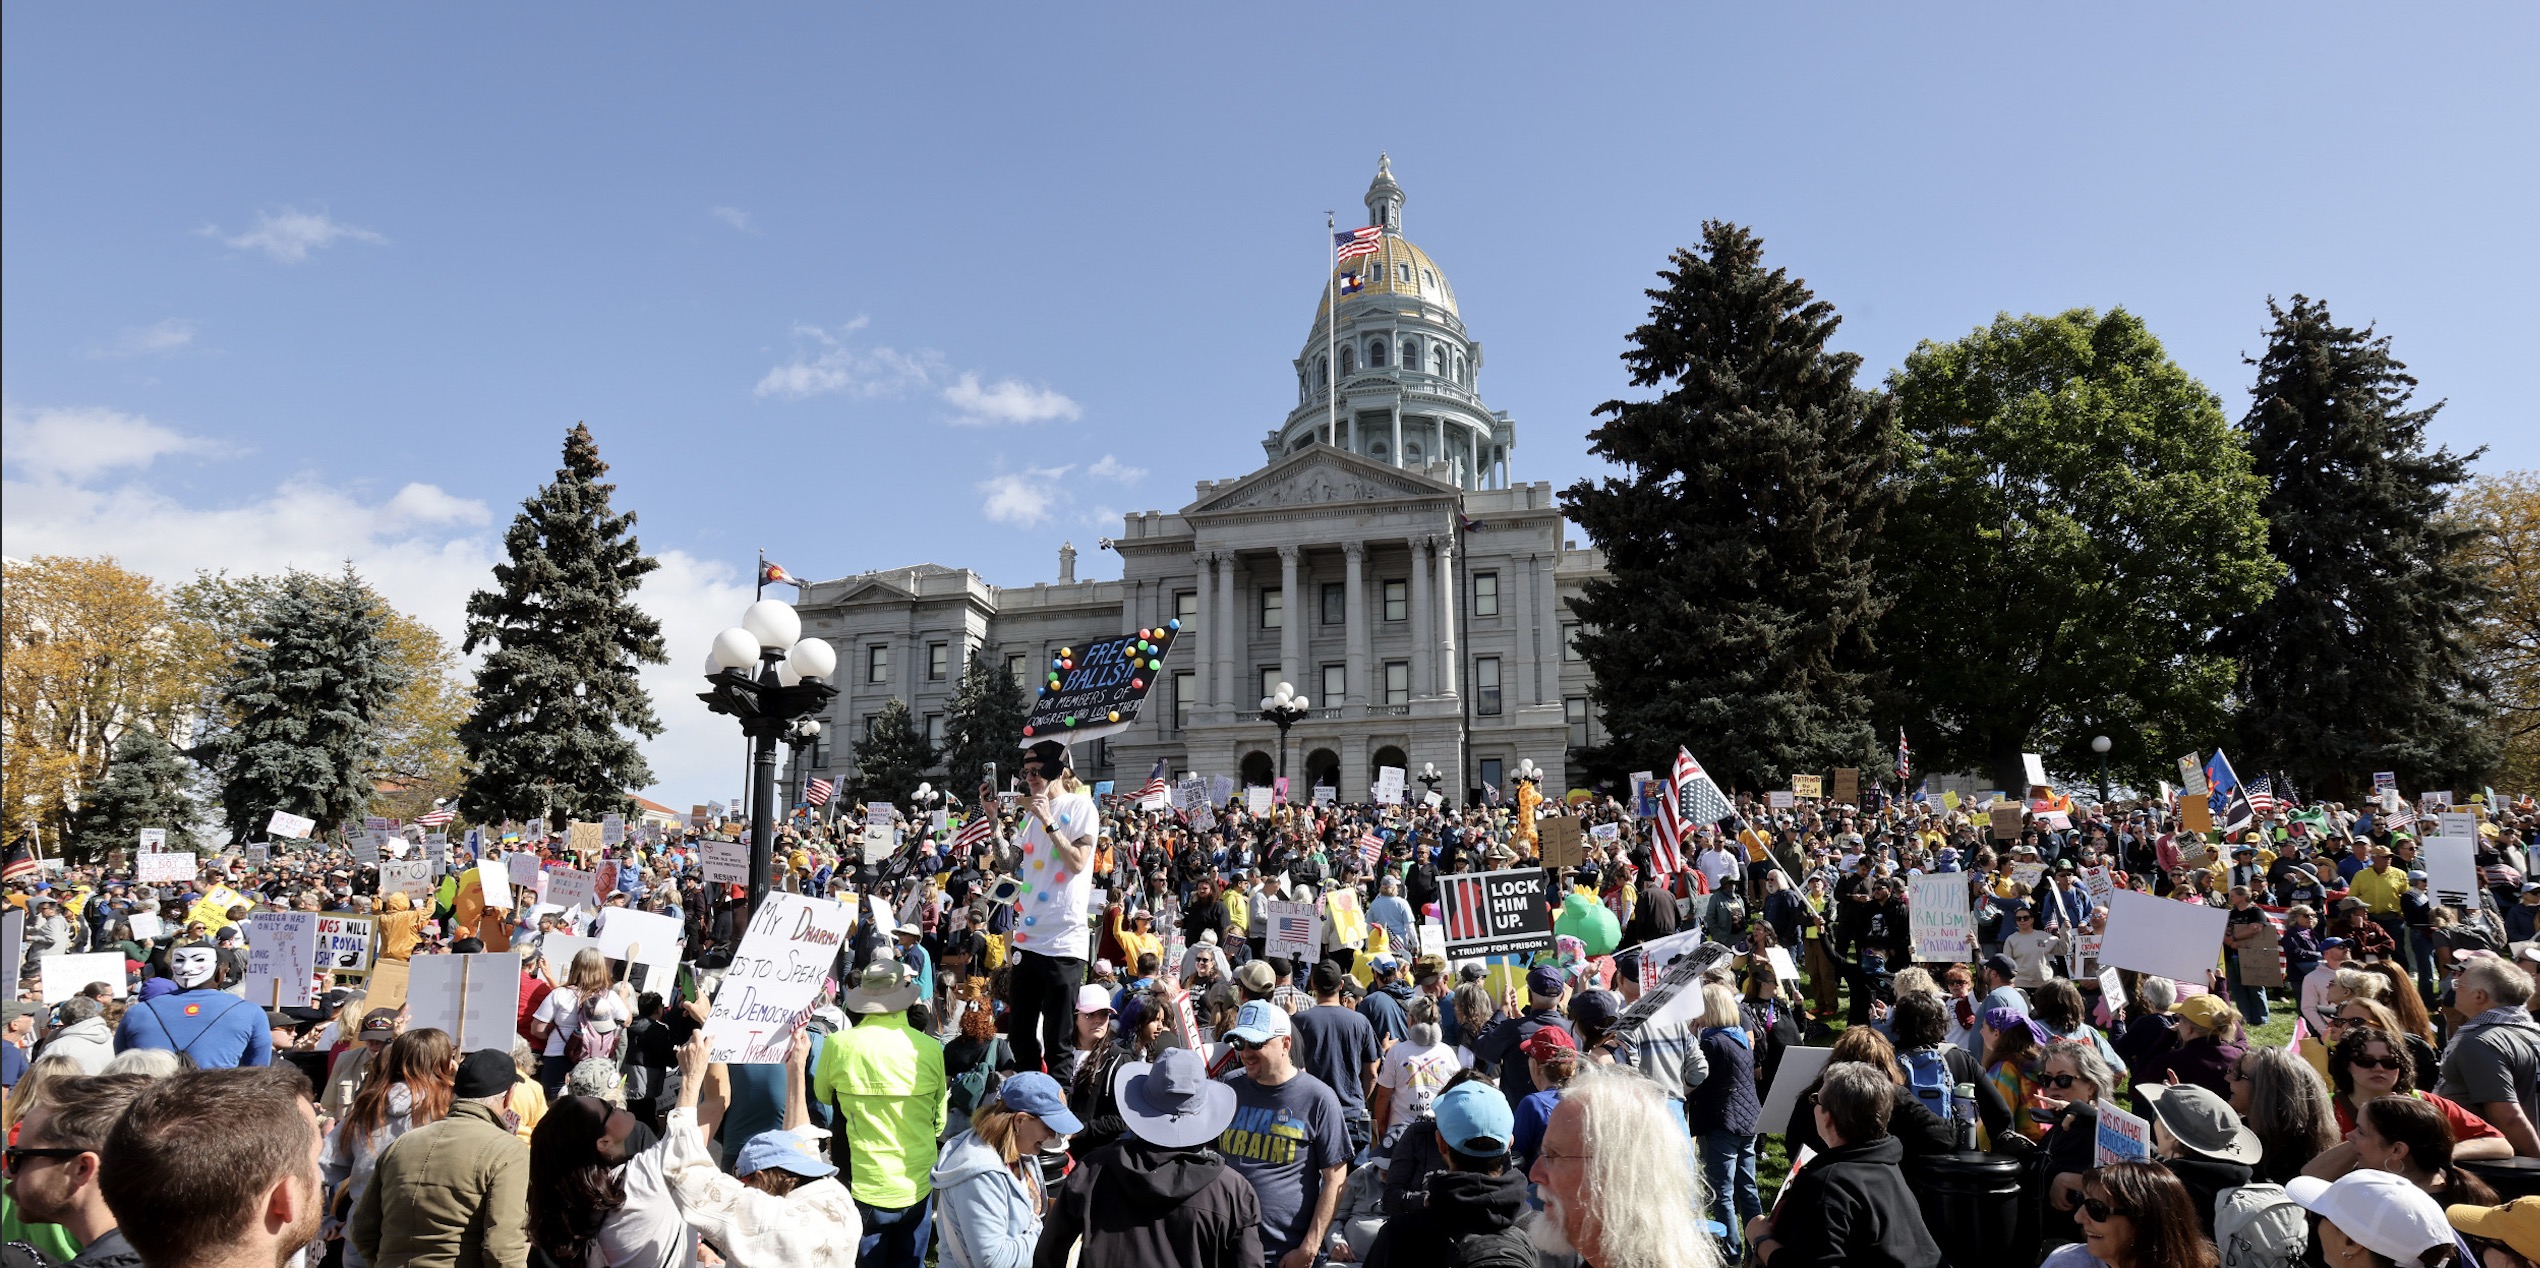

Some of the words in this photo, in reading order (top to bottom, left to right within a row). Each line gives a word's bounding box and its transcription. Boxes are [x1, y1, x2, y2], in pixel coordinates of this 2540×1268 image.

[1082, 637, 1136, 667] FREE
[1062, 660, 1136, 692] BALLS!!
[1036, 699, 1053, 711] FOR
[1056, 689, 1107, 710] MEMBERS
[1114, 686, 1134, 700] OF
[1073, 709, 1087, 720] WHO
[1091, 704, 1115, 719] LOST
[1794, 775, 1820, 783] PATRIOTS
[573, 824, 599, 837] NO
[571, 837, 601, 850] KINGS
[158, 860, 177, 868] NOT
[553, 869, 591, 881] DEMOCRACY
[713, 872, 738, 882] RESIST
[2088, 868, 2100, 877] NO
[968, 878, 984, 887] NO
[1490, 879, 1541, 898] LOCK
[1918, 882, 1962, 909] YOUR
[1301, 903, 1319, 918] KING
[1492, 897, 1529, 913] HIM
[254, 913, 286, 922] AMERICA
[291, 914, 306, 923] HAS
[753, 901, 783, 936] MY
[790, 906, 839, 946] DHARMA
[1495, 914, 1524, 929] UP.
[1916, 909, 1964, 929] RACISM
[258, 922, 282, 931] ONLY
[318, 919, 340, 934] NGS
[346, 921, 367, 935] WILL
[1927, 929, 1936, 937] IS
[1941, 928, 1960, 937] NOT
[273, 931, 295, 941] KING
[319, 935, 326, 949] A
[331, 935, 364, 951] ROYAL
[249, 950, 269, 959] LONG
[1269, 939, 1296, 954] SINCE
[1297, 943, 1318, 958] 1776
[1458, 946, 1489, 957] TRUMP
[1491, 943, 1509, 953] FOR
[1510, 940, 1543, 952] PRISON
[248, 963, 269, 974] LIVE
[729, 956, 750, 976] IS
[752, 959, 772, 978] TO
[777, 949, 827, 985] SPEAK
[731, 986, 801, 1024] DEMOCRAC
[709, 1048, 737, 1061] AINST
[742, 1031, 786, 1062] TYRANN
[1418, 1091, 1430, 1099] NO
[1410, 1103, 1430, 1112] KING
[1232, 1106, 1273, 1135] AVA
[2101, 1108, 2112, 1129] THIS
[2113, 1115, 2121, 1133] IS
[2121, 1119, 2142, 1143] WHAT
[2098, 1123, 2142, 1156] DEMOCRACY
